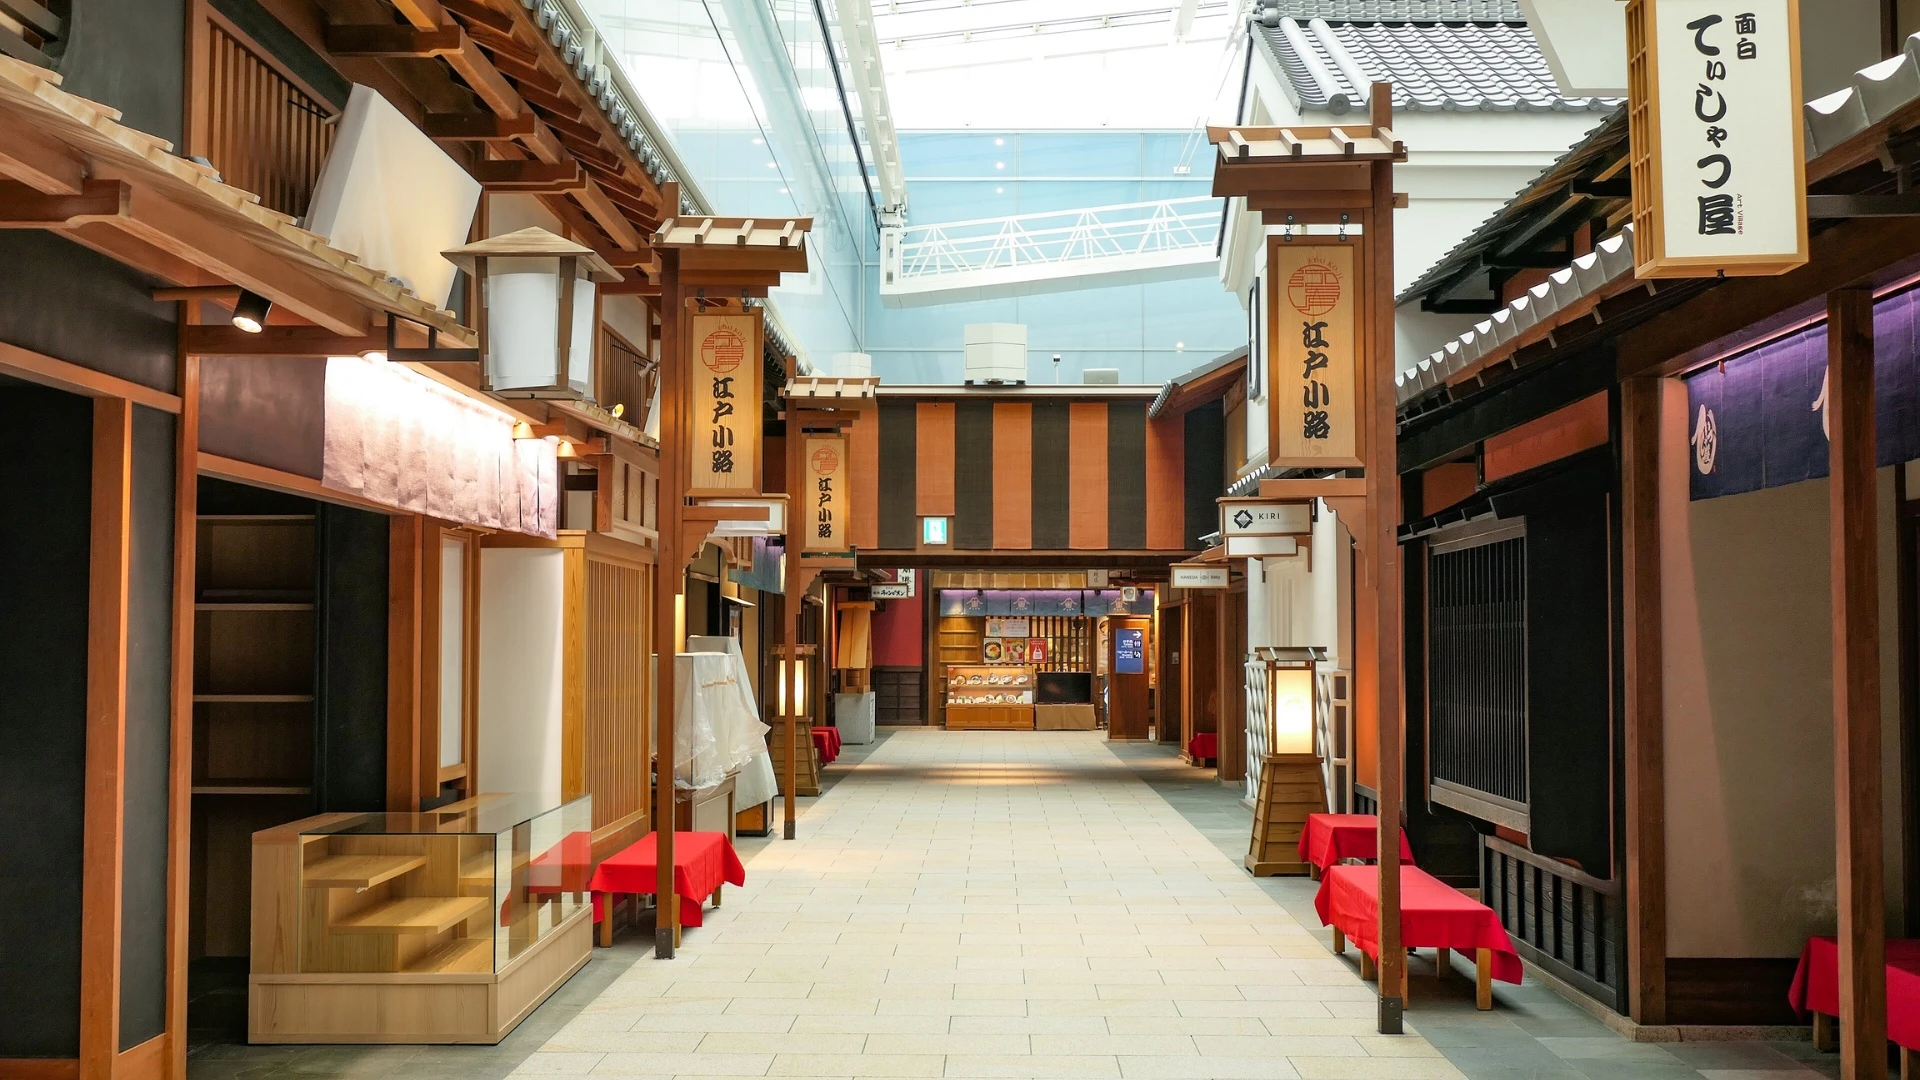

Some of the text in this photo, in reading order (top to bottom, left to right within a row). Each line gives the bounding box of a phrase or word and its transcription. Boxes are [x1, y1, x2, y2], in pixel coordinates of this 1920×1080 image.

[1735, 12, 1757, 60] 面白
[1686, 14, 1737, 236] てぃしゃつ屋
[1302, 321, 1331, 440] 江戸小路
[712, 376, 734, 473] 江戸小路
[817, 477, 833, 539] 江戸小路
[1258, 512, 1280, 520] KIRI
